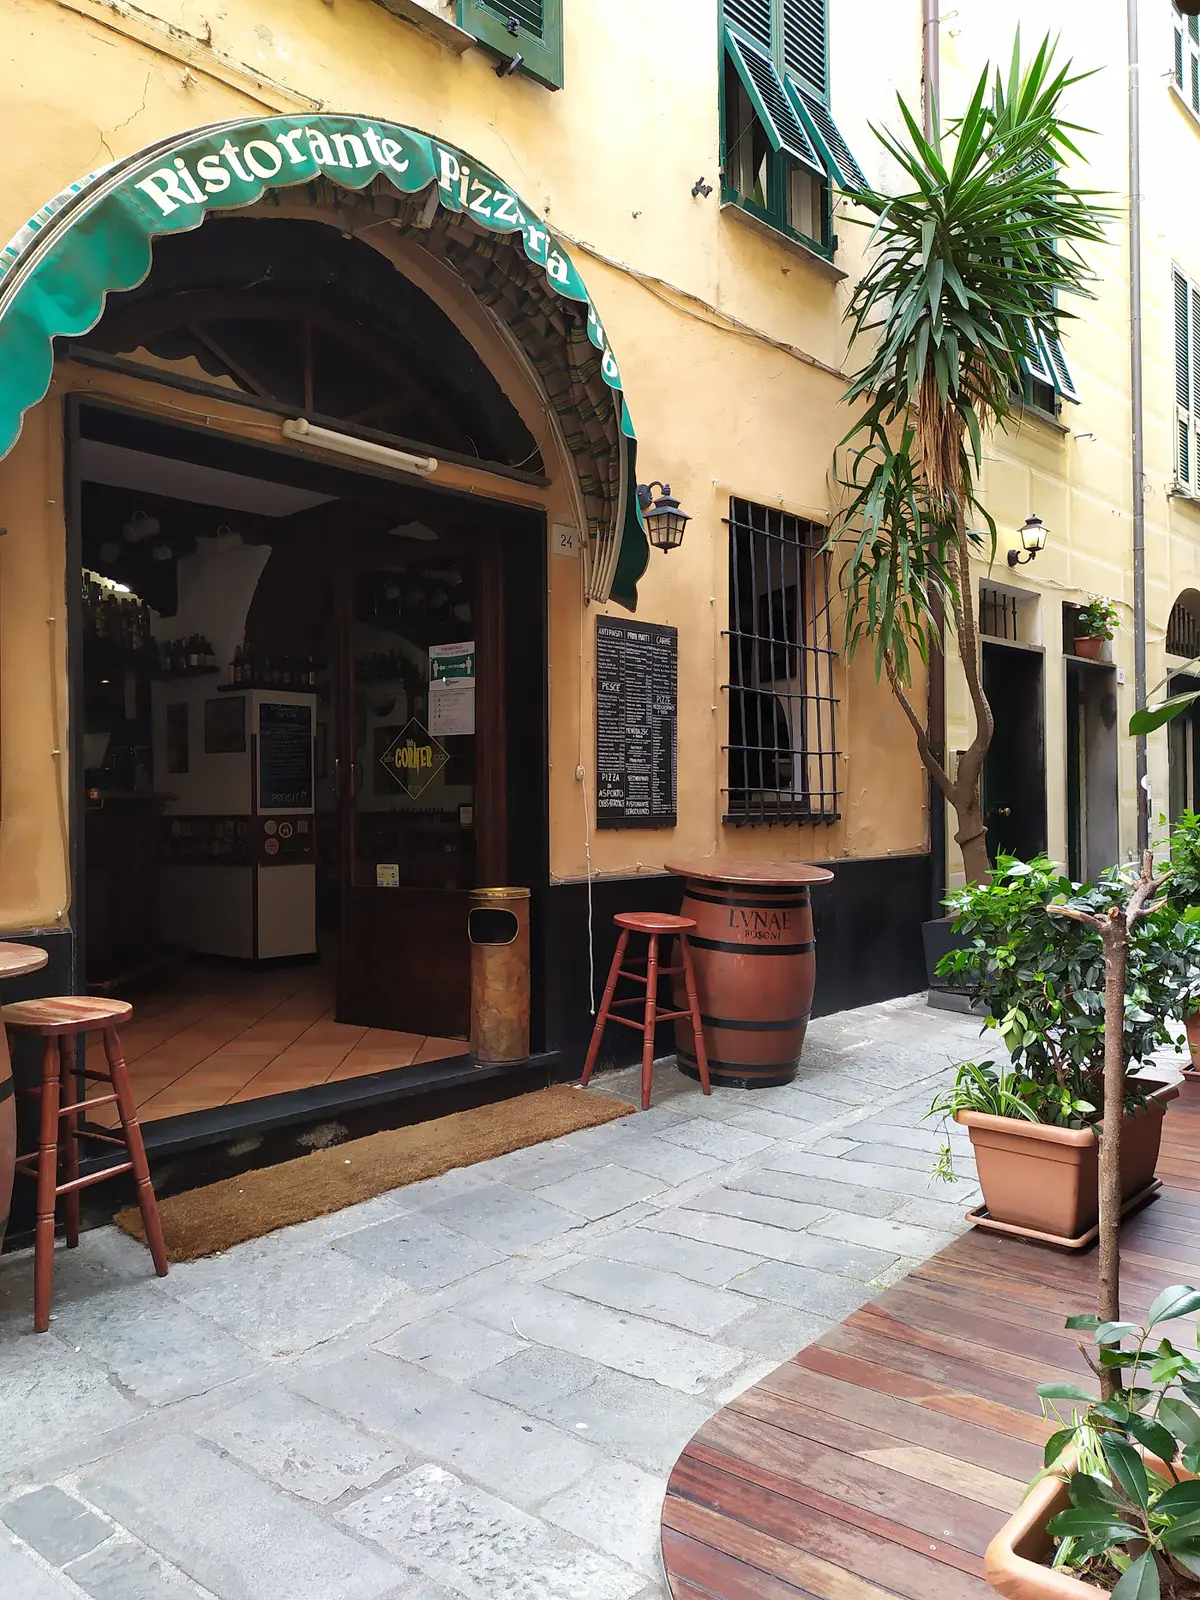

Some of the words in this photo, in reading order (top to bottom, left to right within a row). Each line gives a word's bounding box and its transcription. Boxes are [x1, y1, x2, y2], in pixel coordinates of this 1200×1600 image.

[134, 126, 409, 217] Ristorante
[437, 148, 570, 284] Pizzria
[560, 533, 573, 549] 24
[598, 628, 623, 637] ANTIPASTI
[656, 636, 671, 645] CARNE
[602, 683, 620, 691] PESCE
[656, 695, 671, 705] PIZZE
[395, 742, 433, 774] CORNER
[602, 773, 620, 781] PIZZA
[598, 789, 624, 797] ASPORTO
[745, 929, 781, 940] BOSONI
